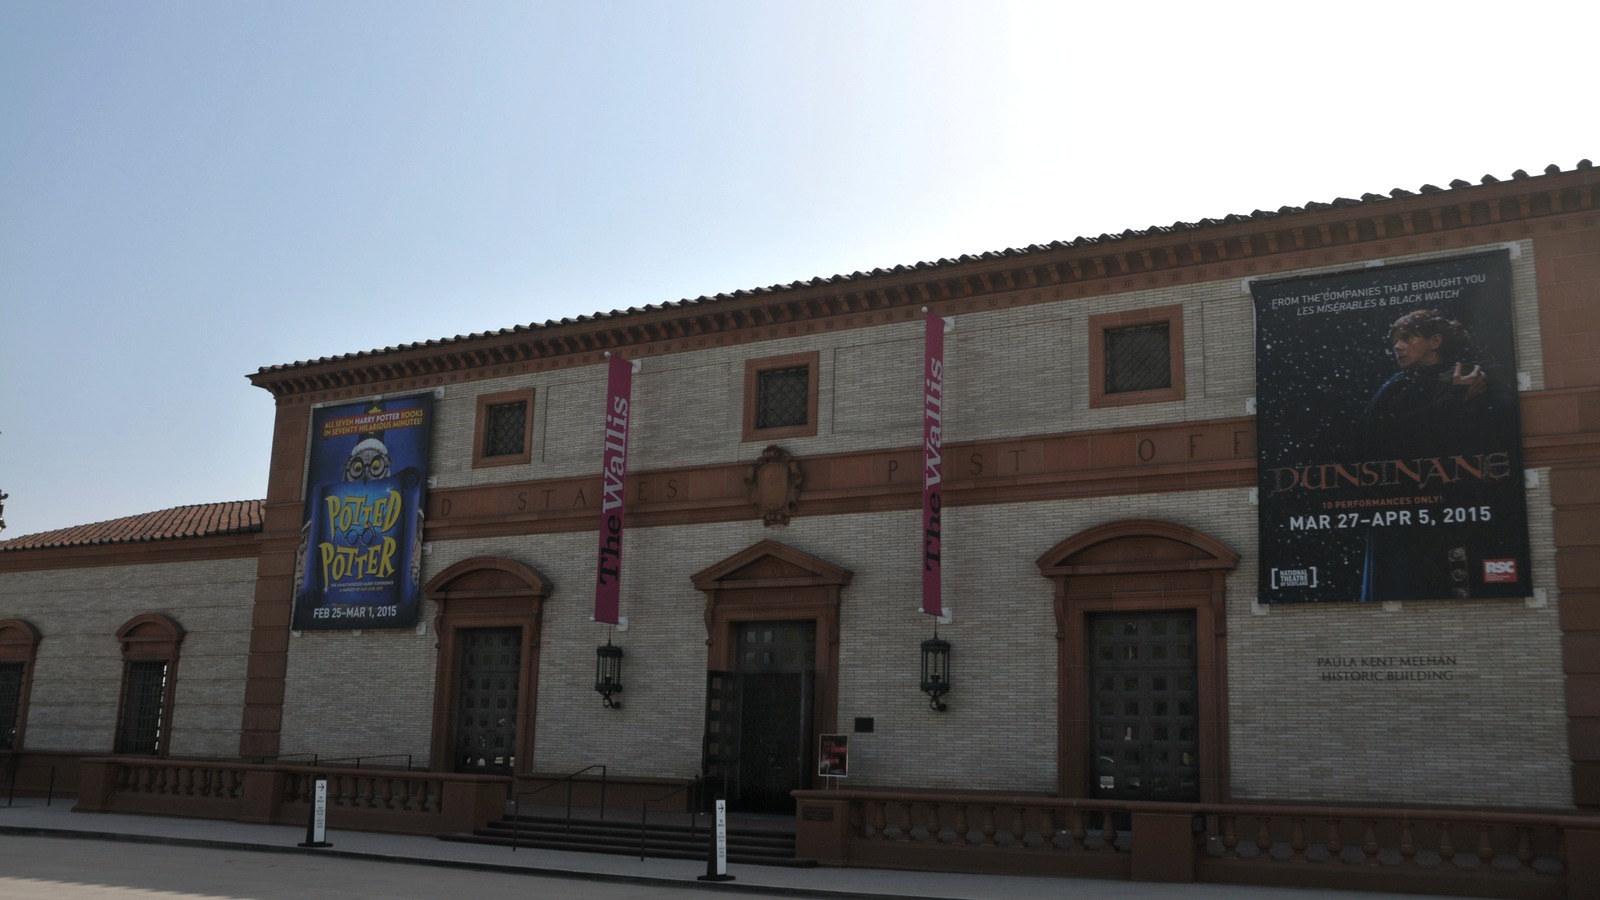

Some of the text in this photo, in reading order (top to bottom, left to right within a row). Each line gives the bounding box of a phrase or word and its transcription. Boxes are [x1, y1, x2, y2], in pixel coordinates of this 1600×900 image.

[1271, 273, 1486, 309] FROM THE COMPANIES THAT BROUGHT YOU
[1296, 306, 1315, 316] LES
[1378, 297, 1387, 307] &
[1389, 293, 1423, 305] BLACK
[1424, 289, 1460, 301] WATCH
[323, 428, 331, 436] IN
[332, 425, 358, 435] SEVENTY
[359, 422, 392, 432] HILARIOUS
[324, 409, 424, 429] ALL SEVEN HARRY POTTER BOOKS
[925, 357, 943, 573] The Wallis
[1267, 452, 1510, 493] DUNSINANE
[517, 479, 678, 511] STAES
[887, 449, 1026, 481] PST
[599, 396, 628, 585] The Wallis
[1322, 495, 1444, 510] 10 PERFORMANCES ONLY!
[325, 489, 402, 543] POTTED
[1290, 515, 1331, 531] MAR
[1418, 509, 1437, 526] 5,
[1443, 506, 1492, 523] 2015
[318, 535, 397, 588] POTTER
[1485, 561, 1515, 574] RSC
[313, 608, 330, 619] FEB
[368, 606, 375, 619] 1,
[376, 605, 397, 617] 2015
[1317, 655, 1457, 667] PAULA KENT MEEHAN
[1322, 670, 1454, 681] HISTORIC BUILDING
